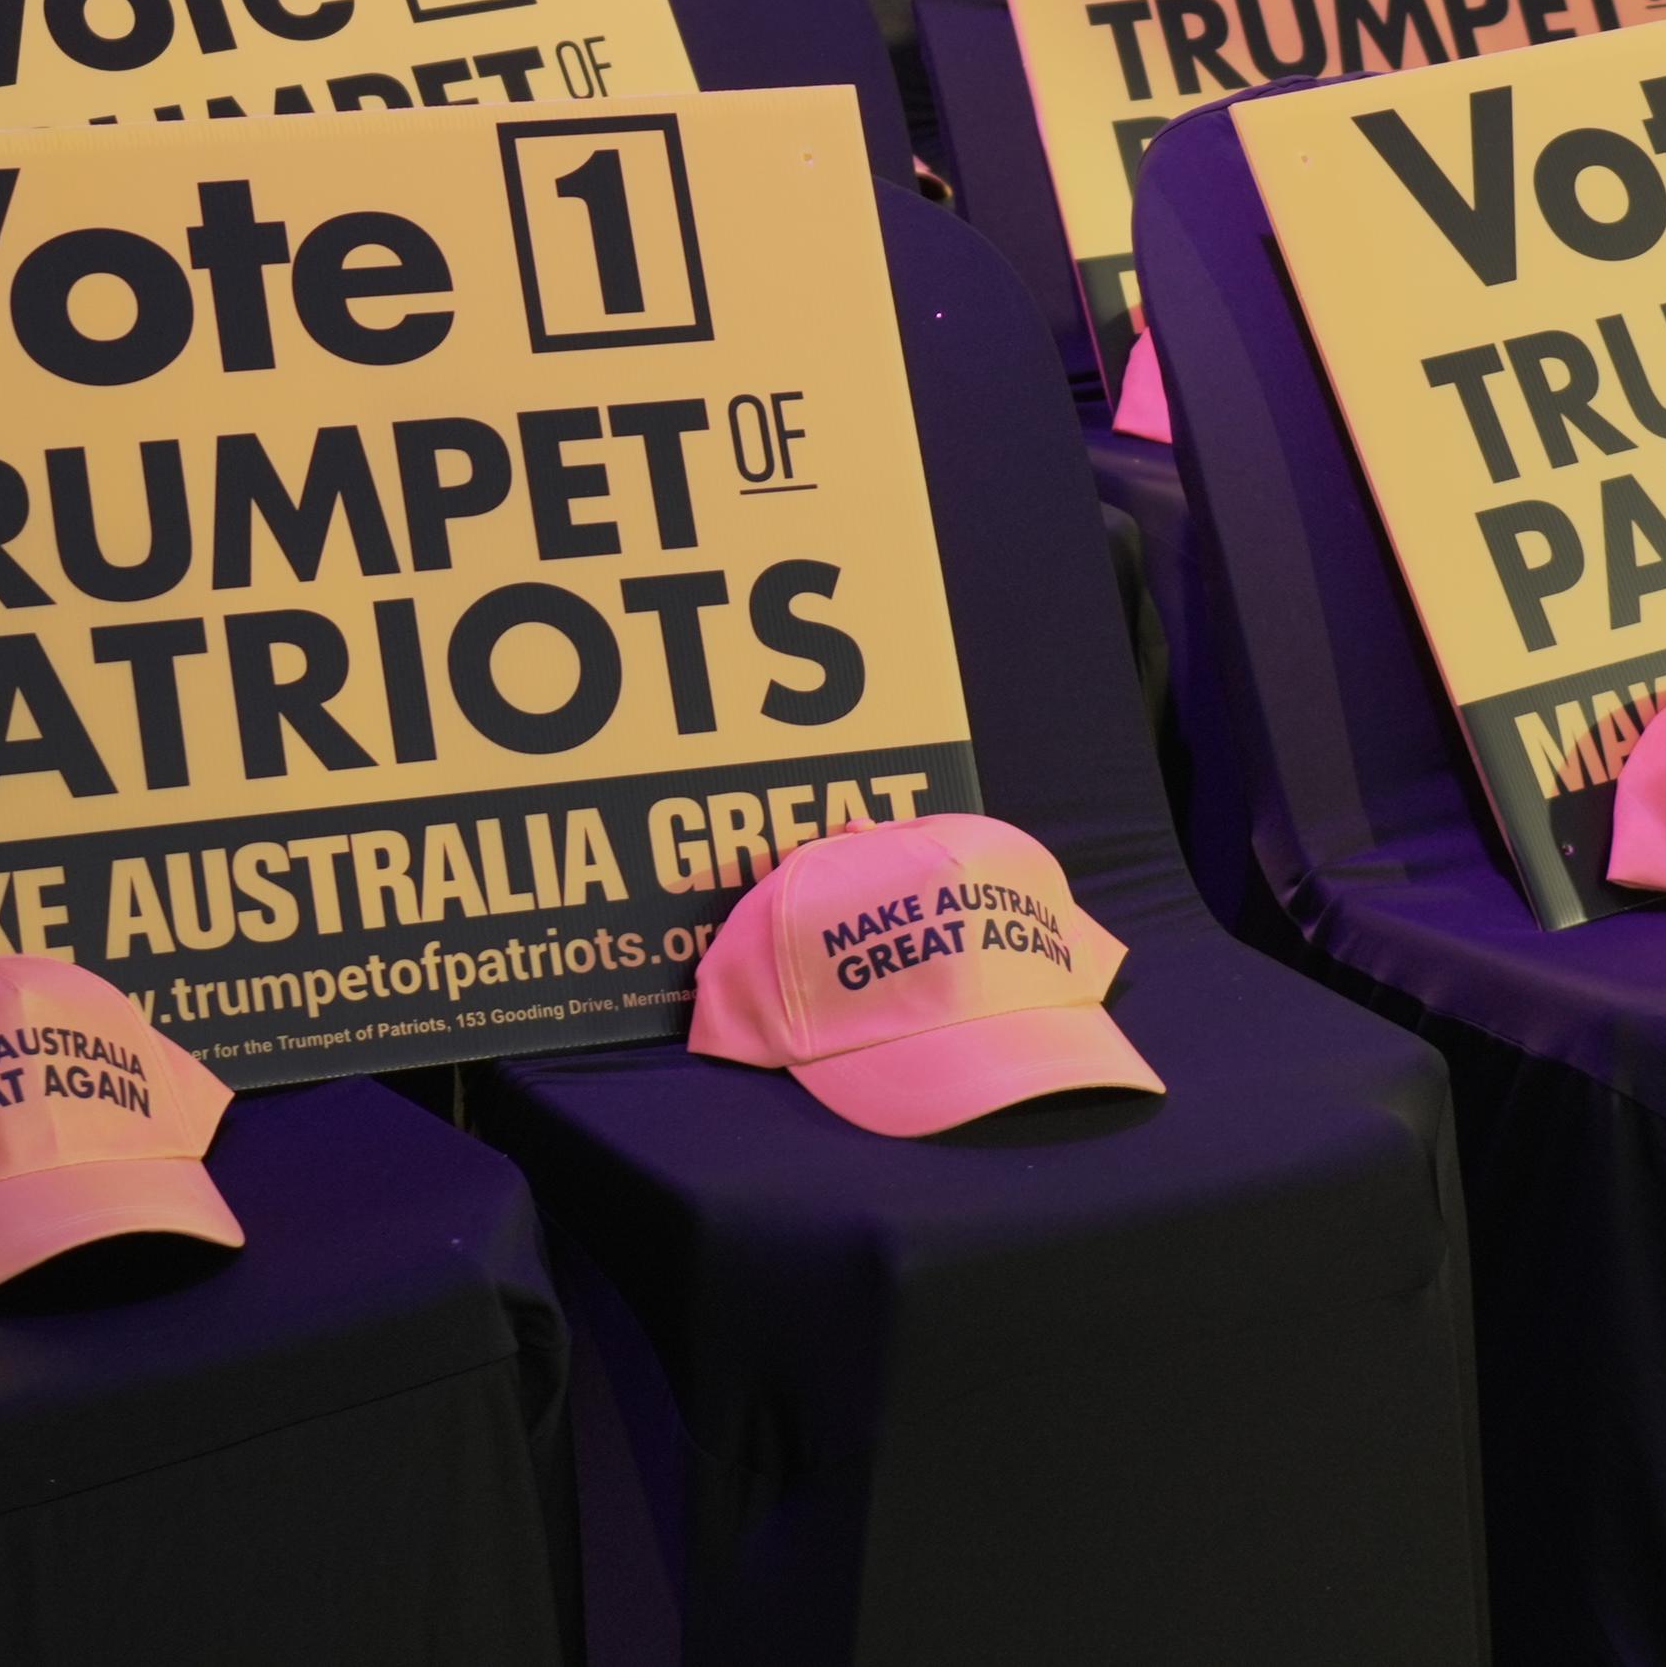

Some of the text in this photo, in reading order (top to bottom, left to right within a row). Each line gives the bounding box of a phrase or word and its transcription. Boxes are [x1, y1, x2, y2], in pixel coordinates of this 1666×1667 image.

[557, 37, 613, 99] OF
[729, 391, 806, 482] OF
[105, 808, 629, 961] AUSTRALIA
[822, 883, 1064, 957] MAKE AUSTRALIA
[837, 918, 1073, 991] GREAT AGAIN
[214, 1040, 239, 1059] for
[244, 1037, 273, 1056] the
[277, 1027, 351, 1053] Trumpet
[355, 1023, 374, 1040] of
[378, 1014, 452, 1040] Patriots,
[455, 1011, 486, 1030] 153
[490, 1000, 565, 1029] Gooding
[569, 994, 619, 1017] Drive,
[44, 1064, 152, 1119] AGAIN
